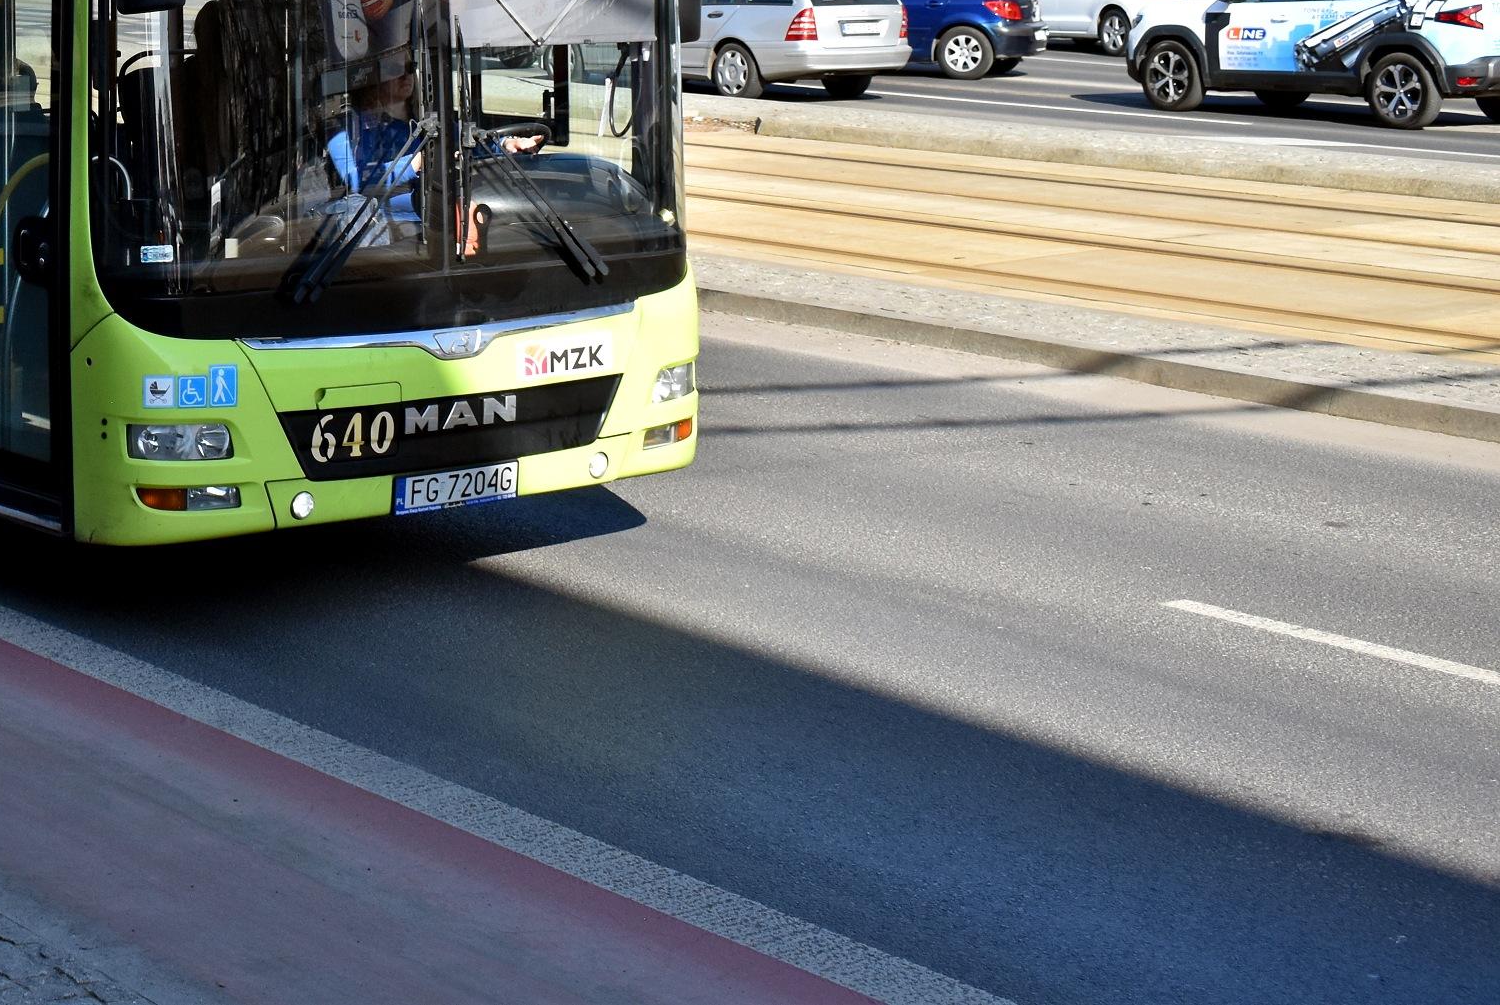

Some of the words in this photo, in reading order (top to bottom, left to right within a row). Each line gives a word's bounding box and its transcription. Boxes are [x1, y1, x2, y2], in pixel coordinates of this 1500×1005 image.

[550, 344, 604, 373] MZK
[404, 394, 517, 435] MAN
[310, 410, 395, 463] 640
[410, 477, 439, 506] FG
[448, 466, 512, 500] 7204G
